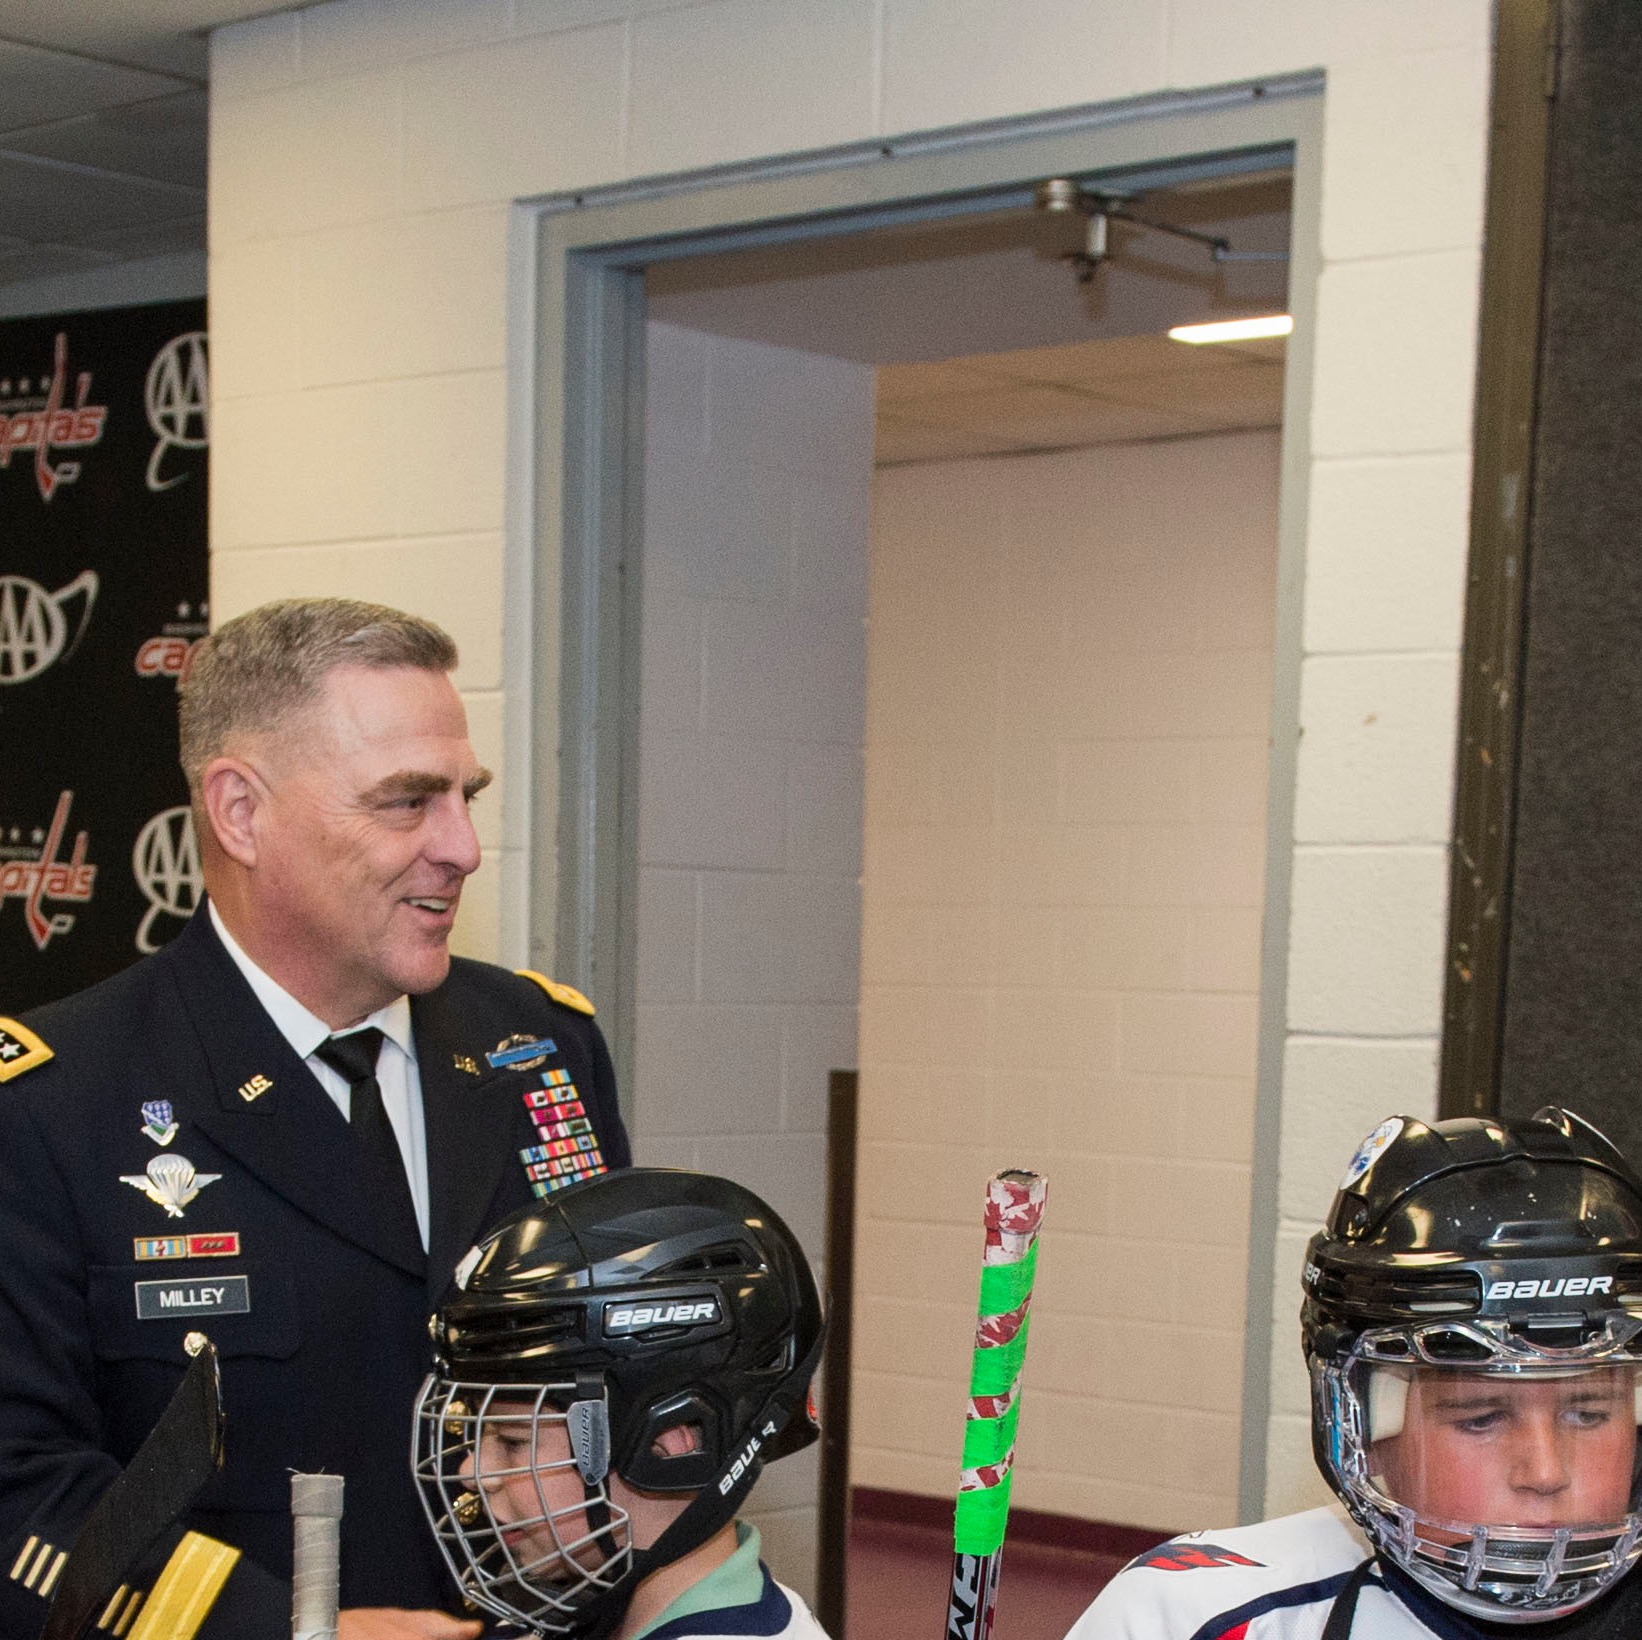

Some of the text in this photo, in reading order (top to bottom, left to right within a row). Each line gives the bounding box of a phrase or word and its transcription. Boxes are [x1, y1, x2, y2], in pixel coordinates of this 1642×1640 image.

[159, 1288, 225, 1309] MILLEY
[1486, 1276, 1614, 1301] BAUER
[609, 1302, 716, 1328] BAUER
